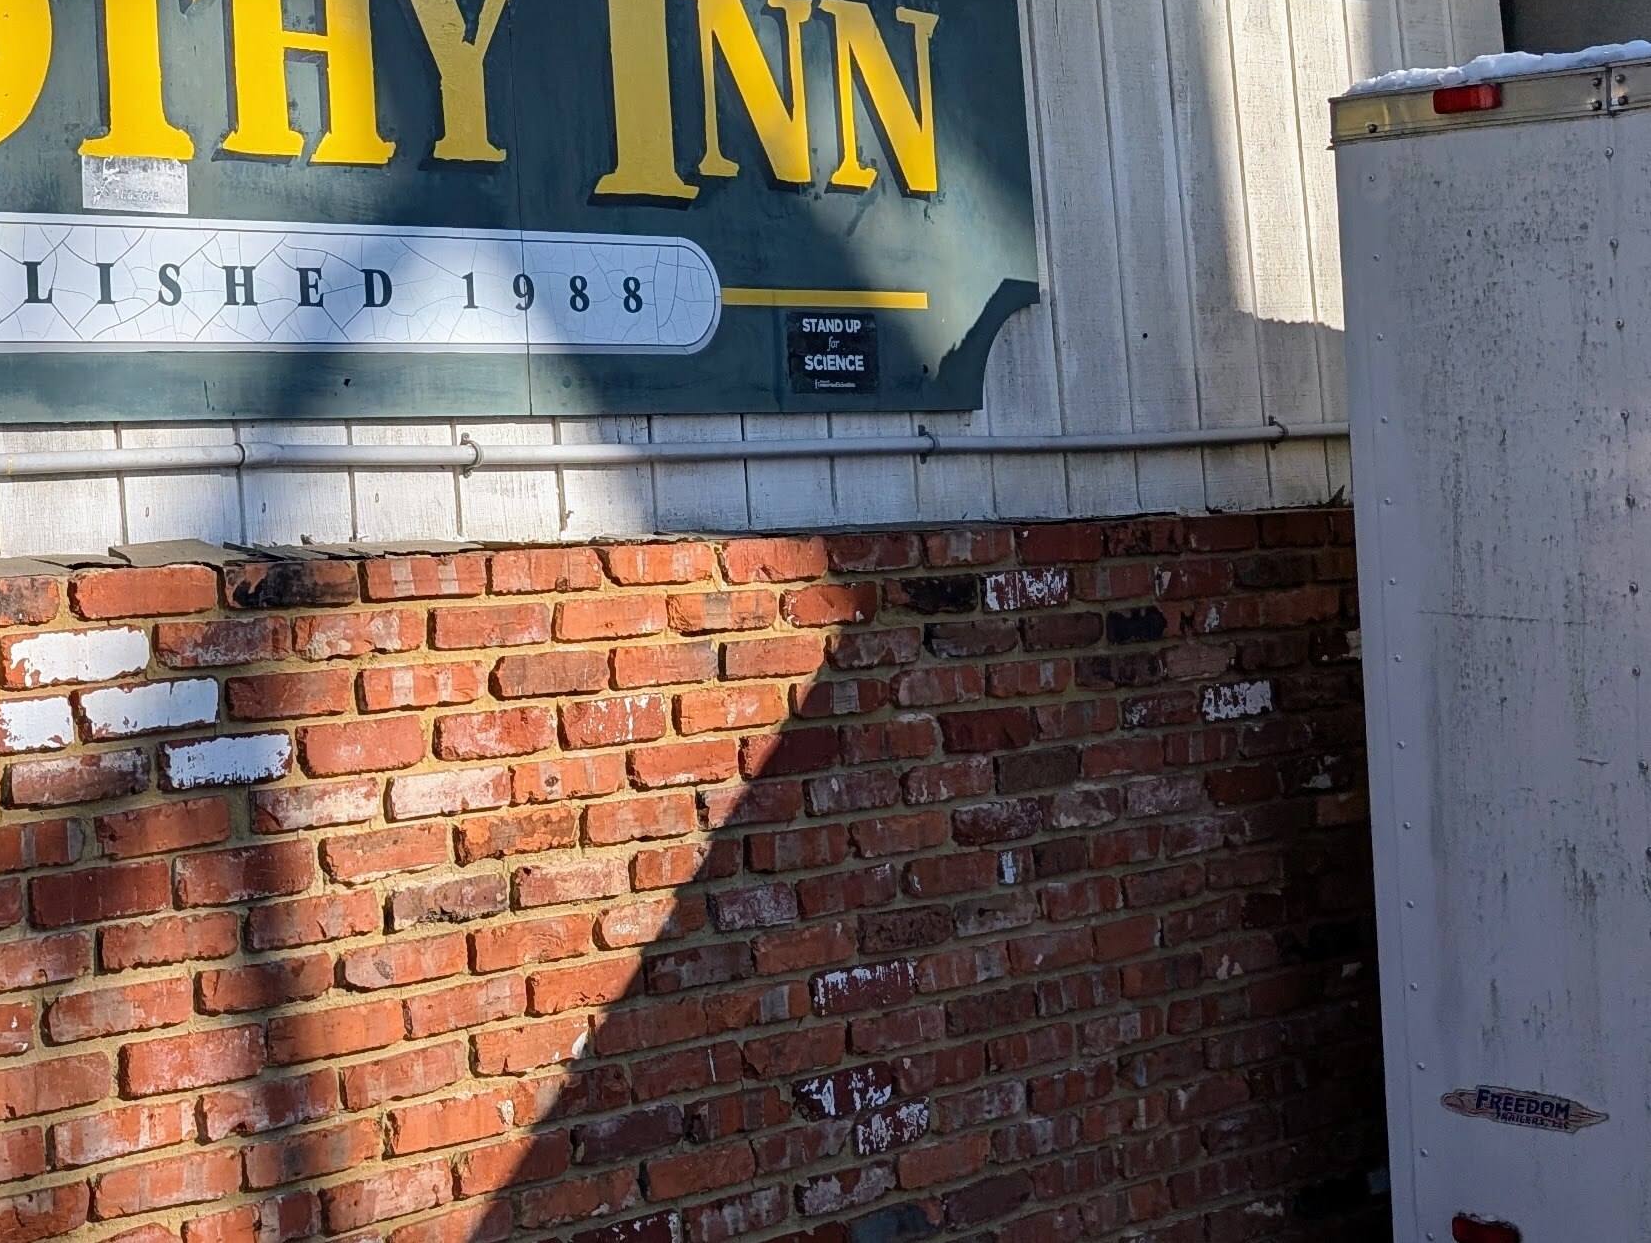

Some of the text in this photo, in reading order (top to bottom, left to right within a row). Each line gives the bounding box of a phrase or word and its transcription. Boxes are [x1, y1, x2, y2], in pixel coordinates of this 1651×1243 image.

[461, 270, 645, 314] 1988
[802, 318, 862, 334] STAND UP
[826, 335, 840, 352] for
[804, 354, 865, 372] SCIENCE
[1475, 1088, 1571, 1120] FREEDOM
